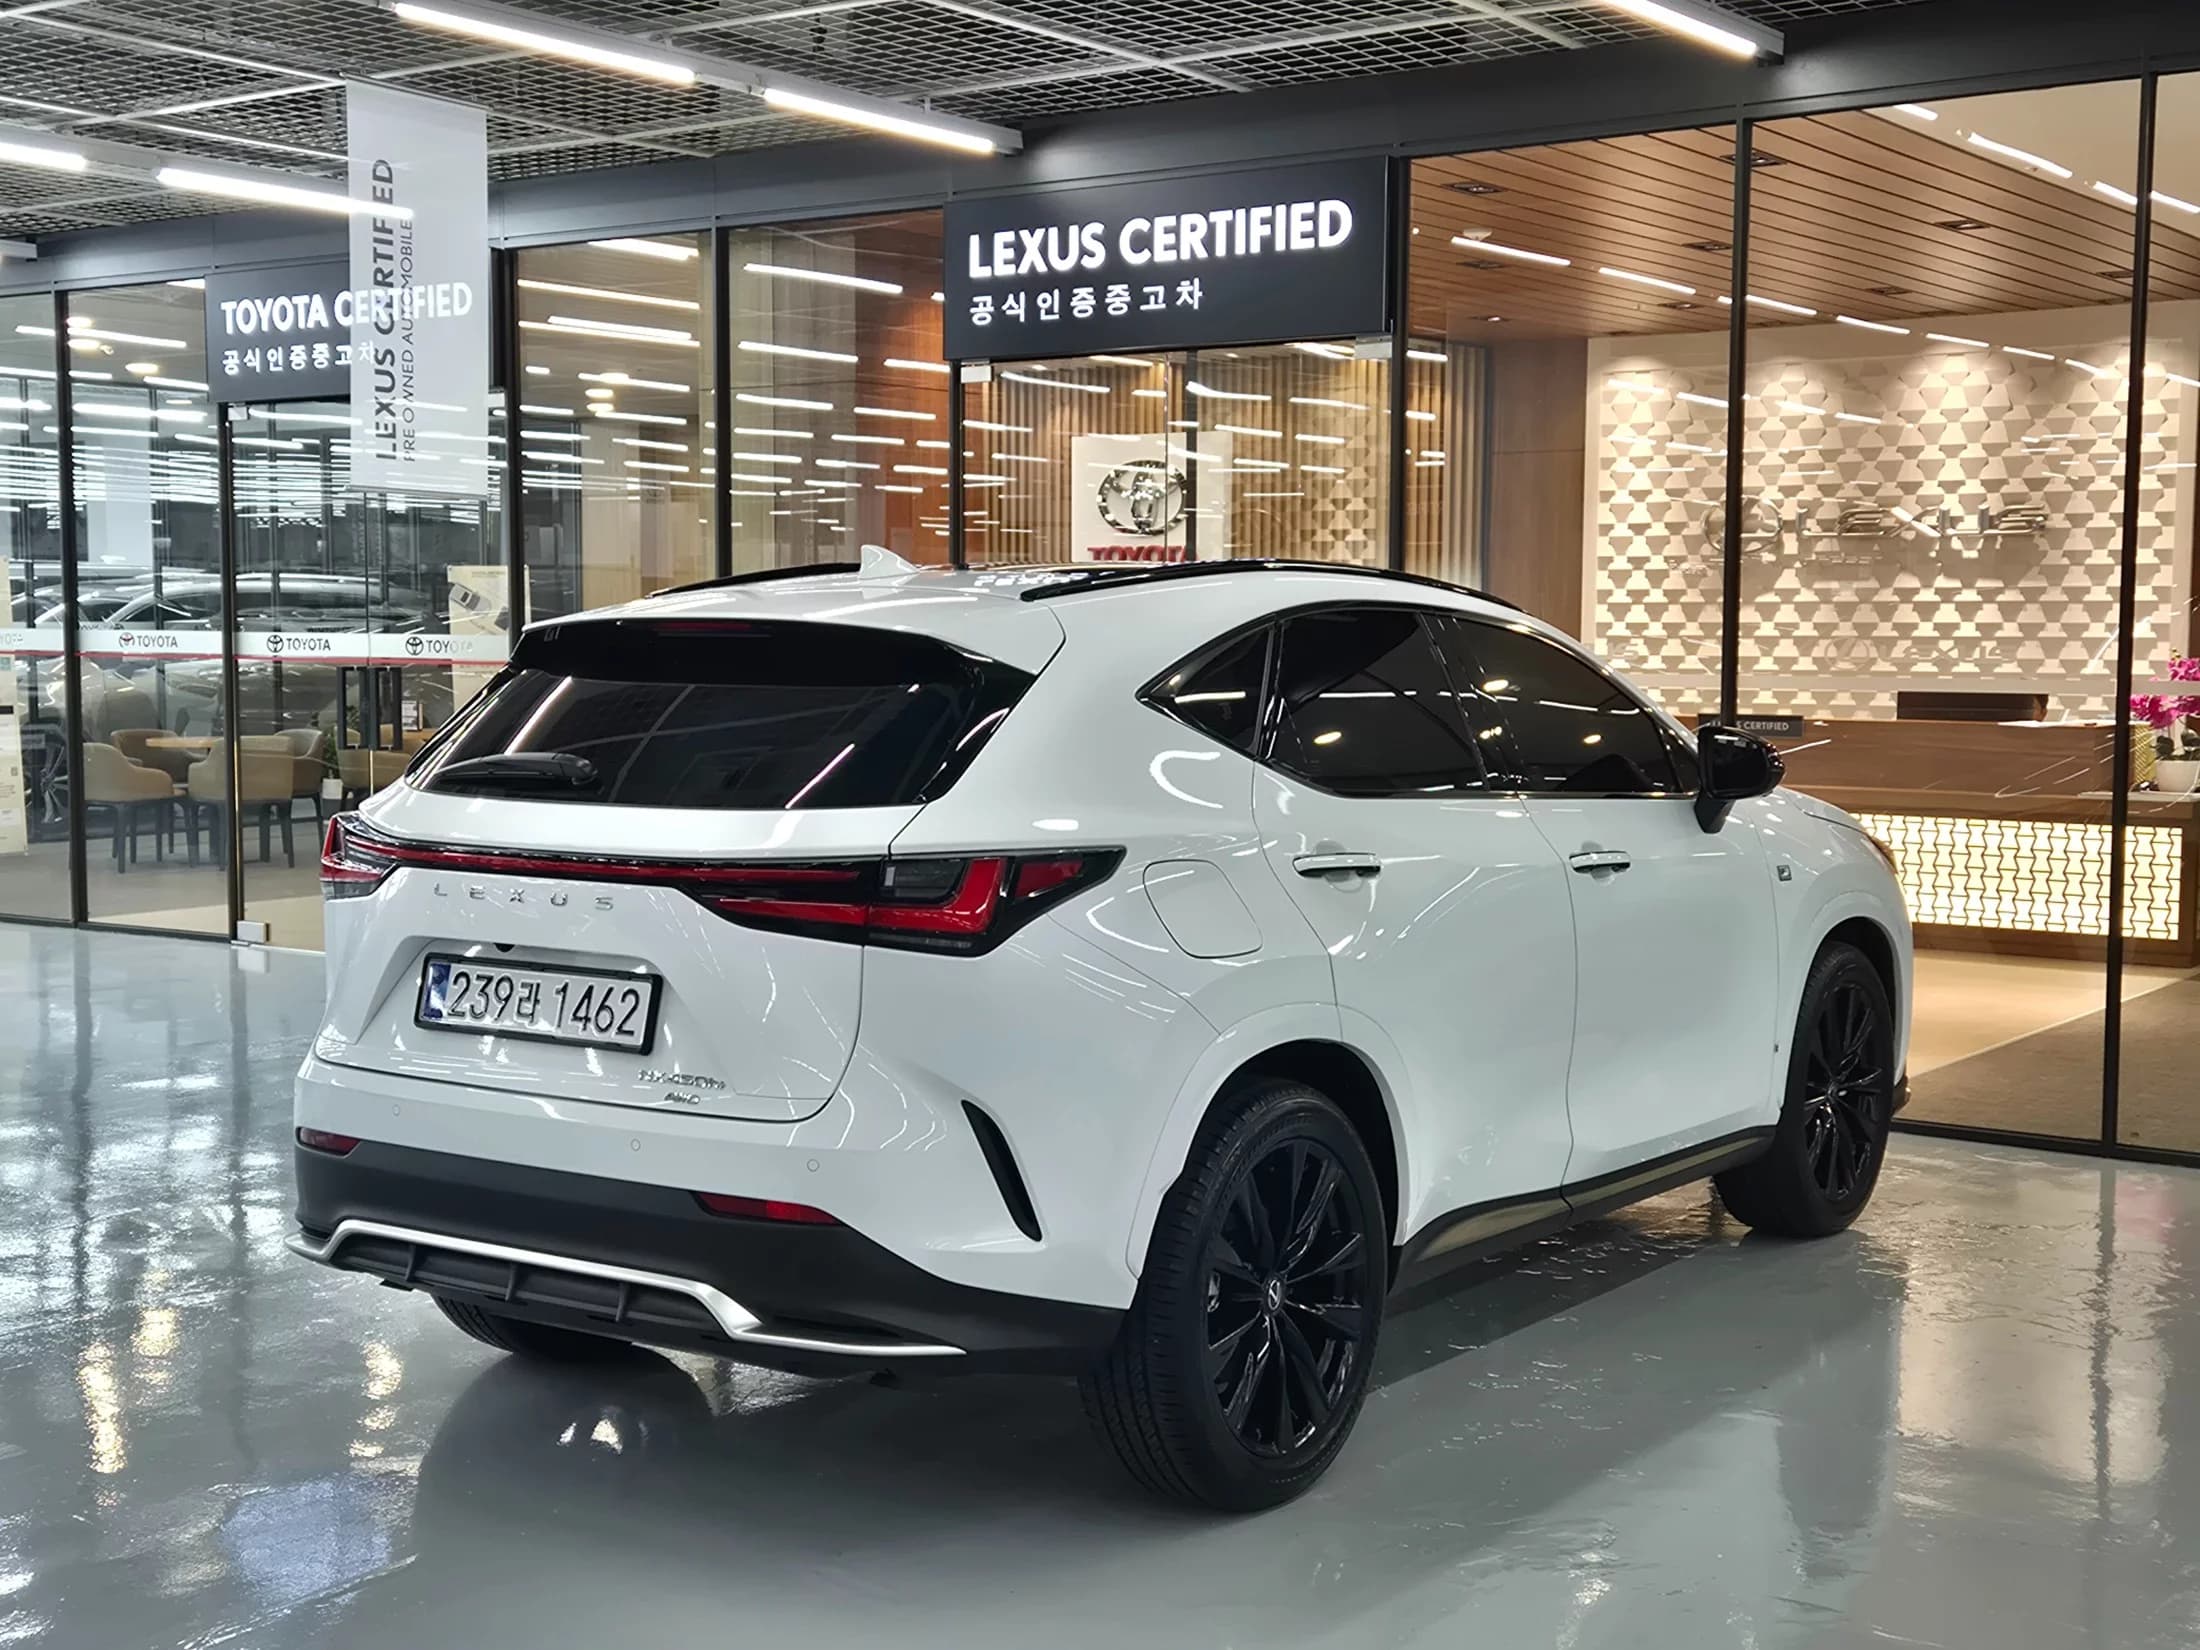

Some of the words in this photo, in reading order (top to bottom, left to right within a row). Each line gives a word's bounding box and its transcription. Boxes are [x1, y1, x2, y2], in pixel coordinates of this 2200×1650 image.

[968, 222, 1107, 279] LEXUS
[1118, 198, 1354, 266] CERTIFIED
[220, 293, 330, 335] TOYOTA
[333, 281, 473, 328] CERTIFIED
[374, 348, 397, 461] LEXUS
[1796, 503, 2047, 539] LEXUS
[136, 634, 179, 649] TOYOTA
[286, 636, 332, 652] TOYOTA
[433, 883, 614, 912] LEXUS
[446, 970, 541, 1024] 239라
[554, 980, 642, 1037] 1462
